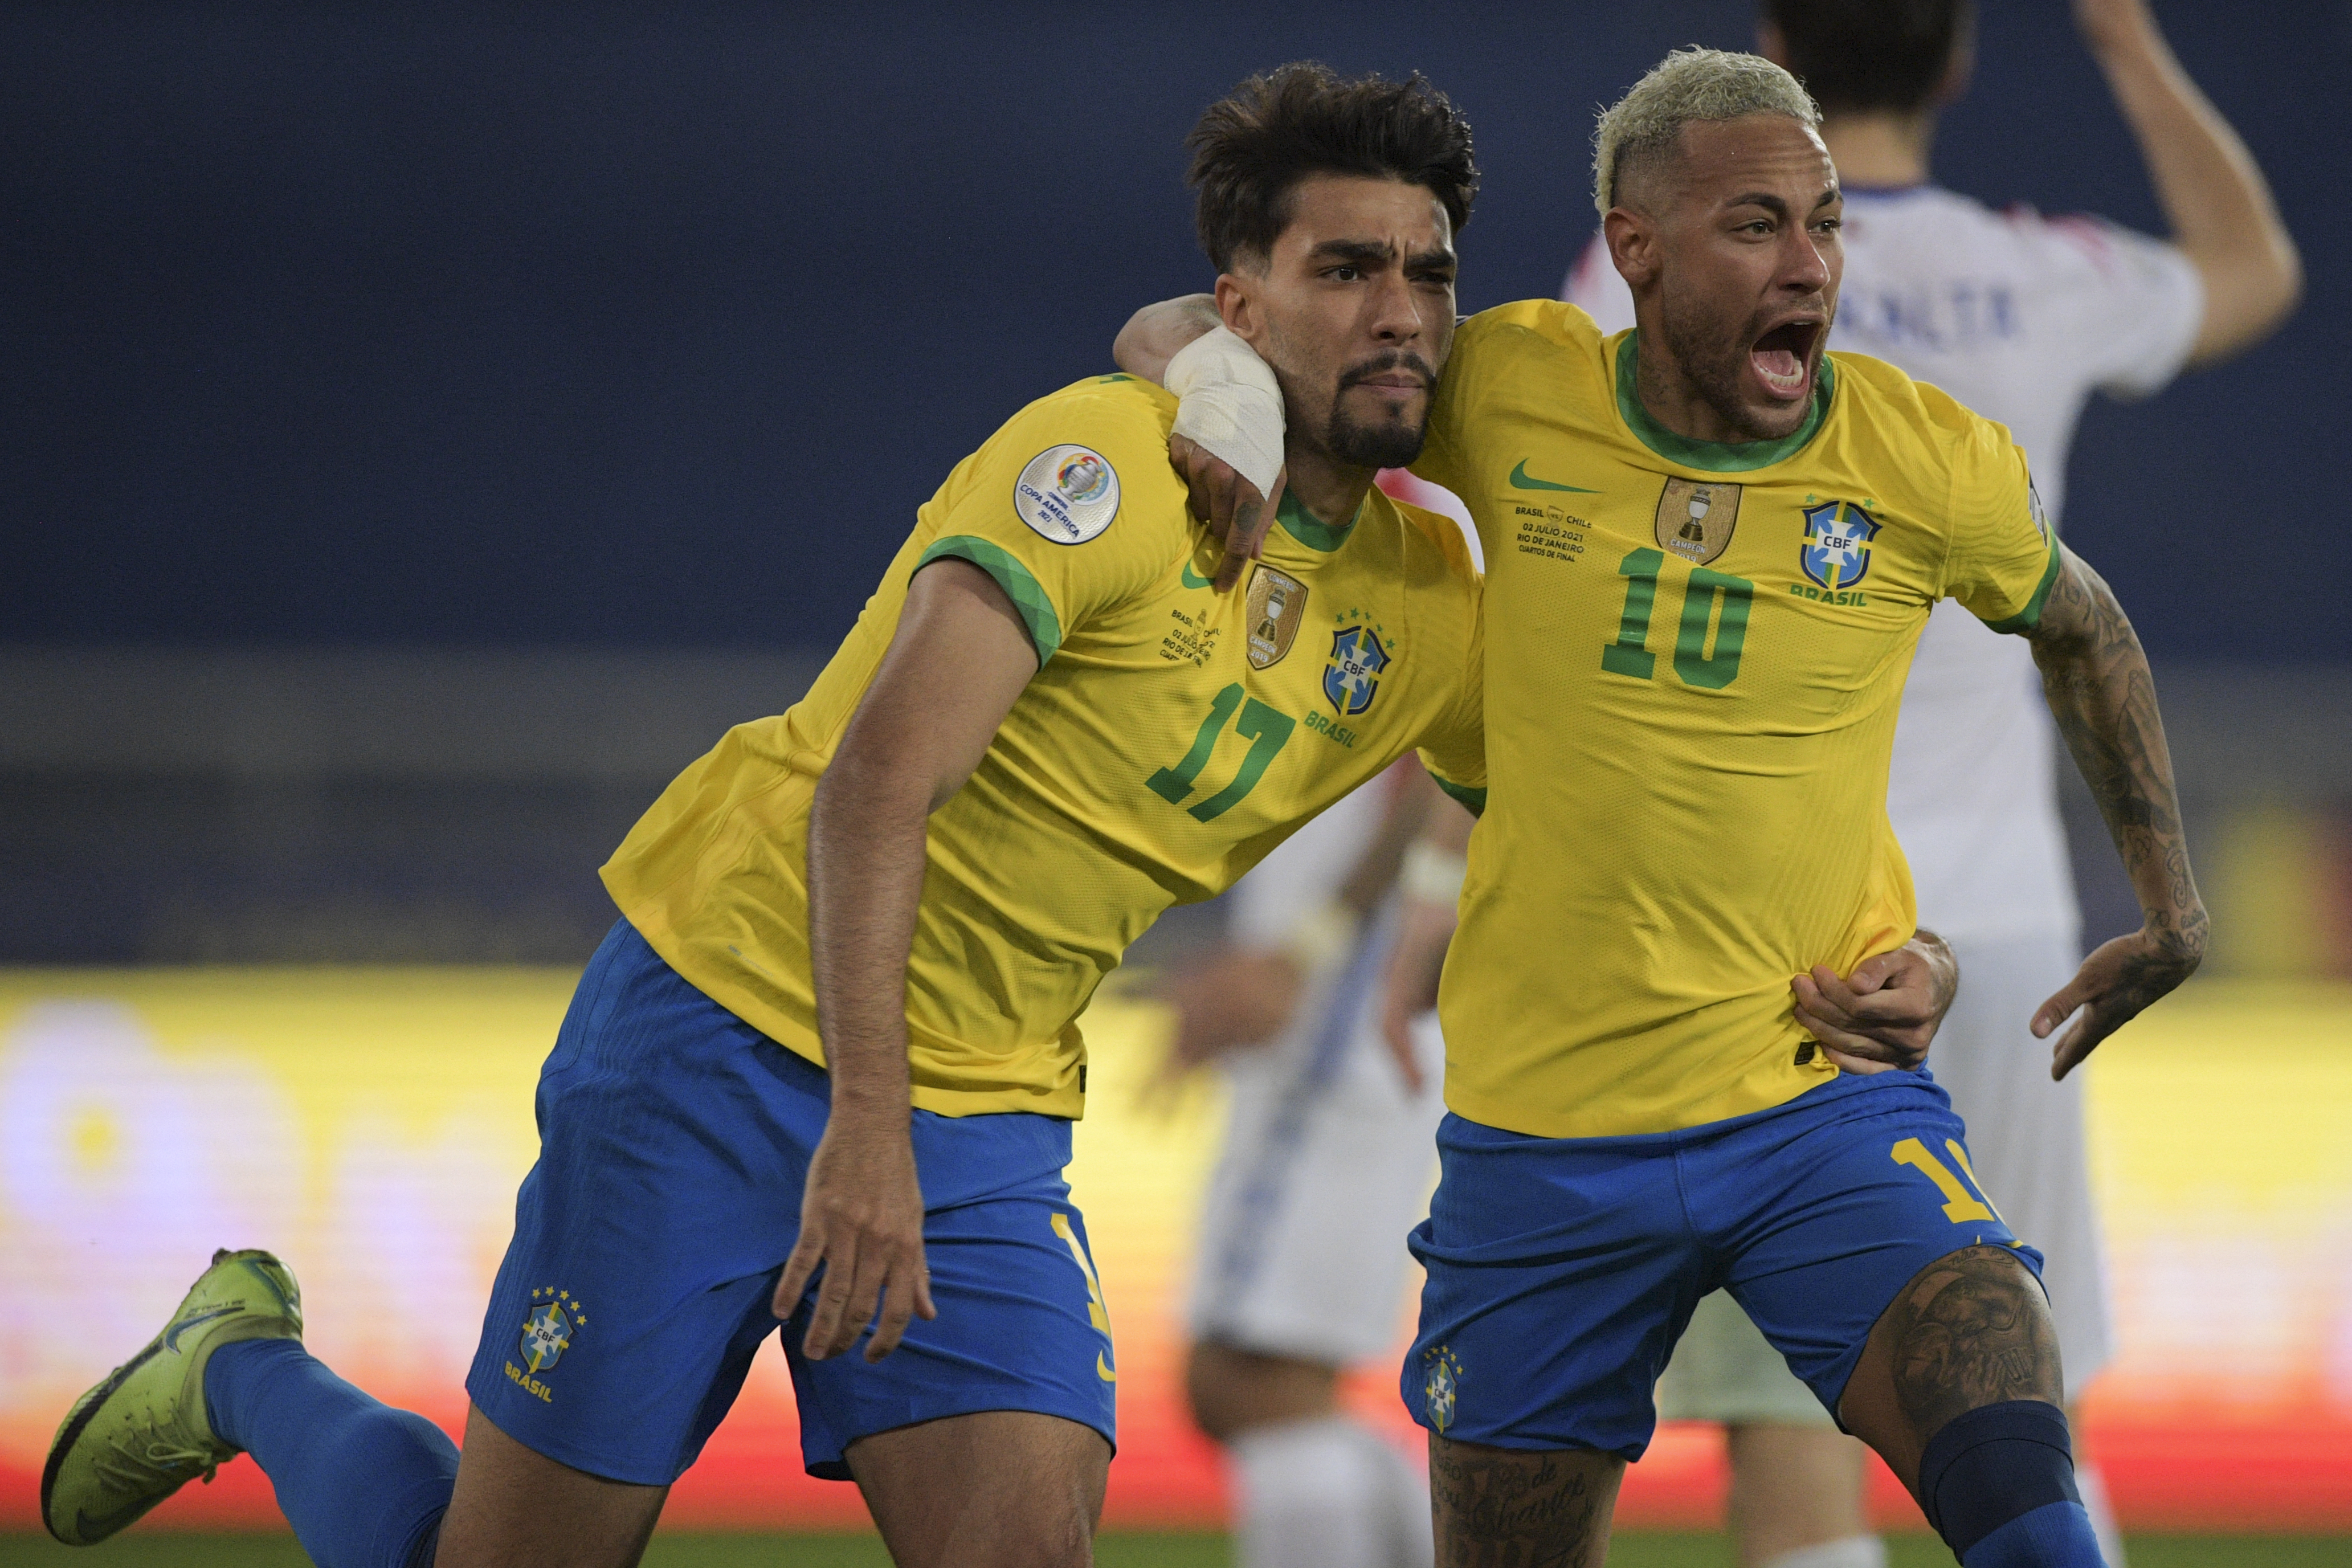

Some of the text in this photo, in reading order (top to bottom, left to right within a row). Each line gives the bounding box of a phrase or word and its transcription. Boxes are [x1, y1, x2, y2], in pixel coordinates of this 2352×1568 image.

[1020, 485, 1079, 537] COPA AMERICA
[1516, 507, 1544, 517] BRASIL
[1567, 516, 1592, 529] CHILE
[1523, 523, 1583, 542] 02 JULIO 2021
[1517, 533, 1584, 554] RIO DE JANEIRO
[1824, 536, 1852, 550] CBF
[1519, 545, 1575, 562] CUARTOS DE FINAL
[1790, 583, 1867, 607] BRASIL
[1171, 610, 1193, 627] BRASIL
[1601, 546, 1754, 690] 10
[1173, 630, 1182, 639] 02
[1162, 638, 1175, 649] RIO
[1175, 645, 1185, 655] DE
[1251, 650, 1268, 663] 2019
[1344, 660, 1365, 677] CBF
[1304, 710, 1360, 749] BRASIL
[1145, 682, 1296, 823] 17
[536, 1328, 556, 1344] CBF
[505, 1361, 552, 1403] BRASIL
